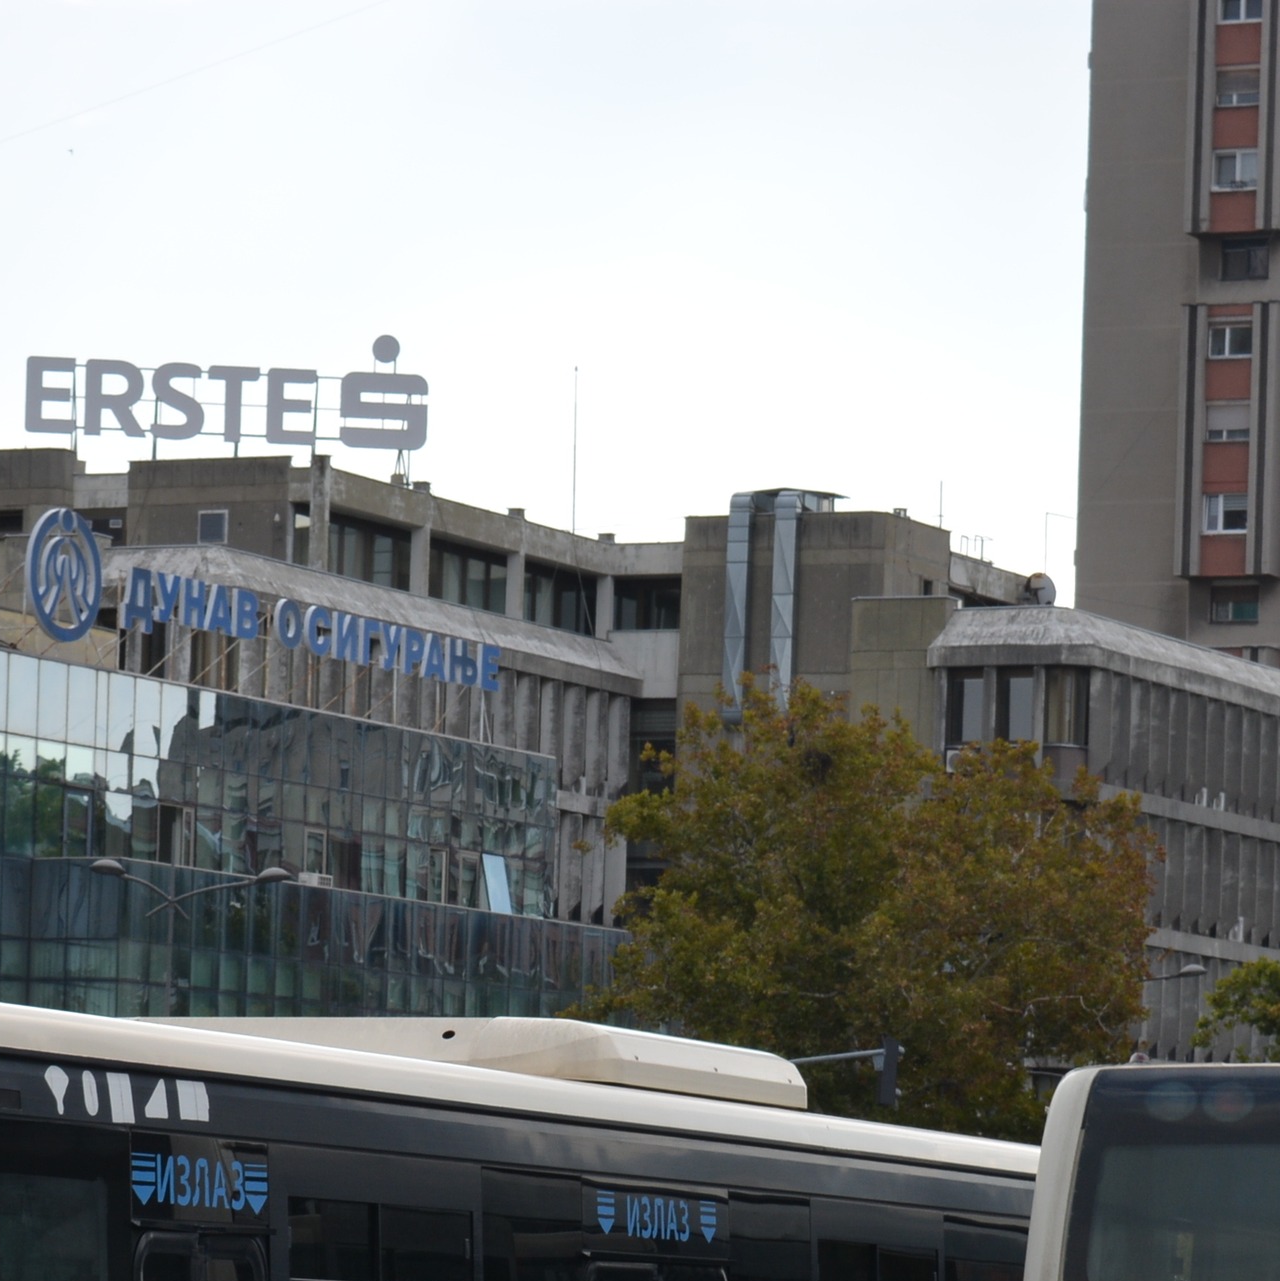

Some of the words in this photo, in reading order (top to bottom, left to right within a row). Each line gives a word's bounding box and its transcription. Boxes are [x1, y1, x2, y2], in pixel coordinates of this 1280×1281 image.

[25, 355, 318, 445] ERSTE
[123, 566, 260, 640] ДУНАВ
[273, 598, 502, 692] ОСИГУРАЊЕ
[156, 1153, 246, 1211] ИЗЛАЗ
[626, 1194, 689, 1242] ИЗЛАЗ
